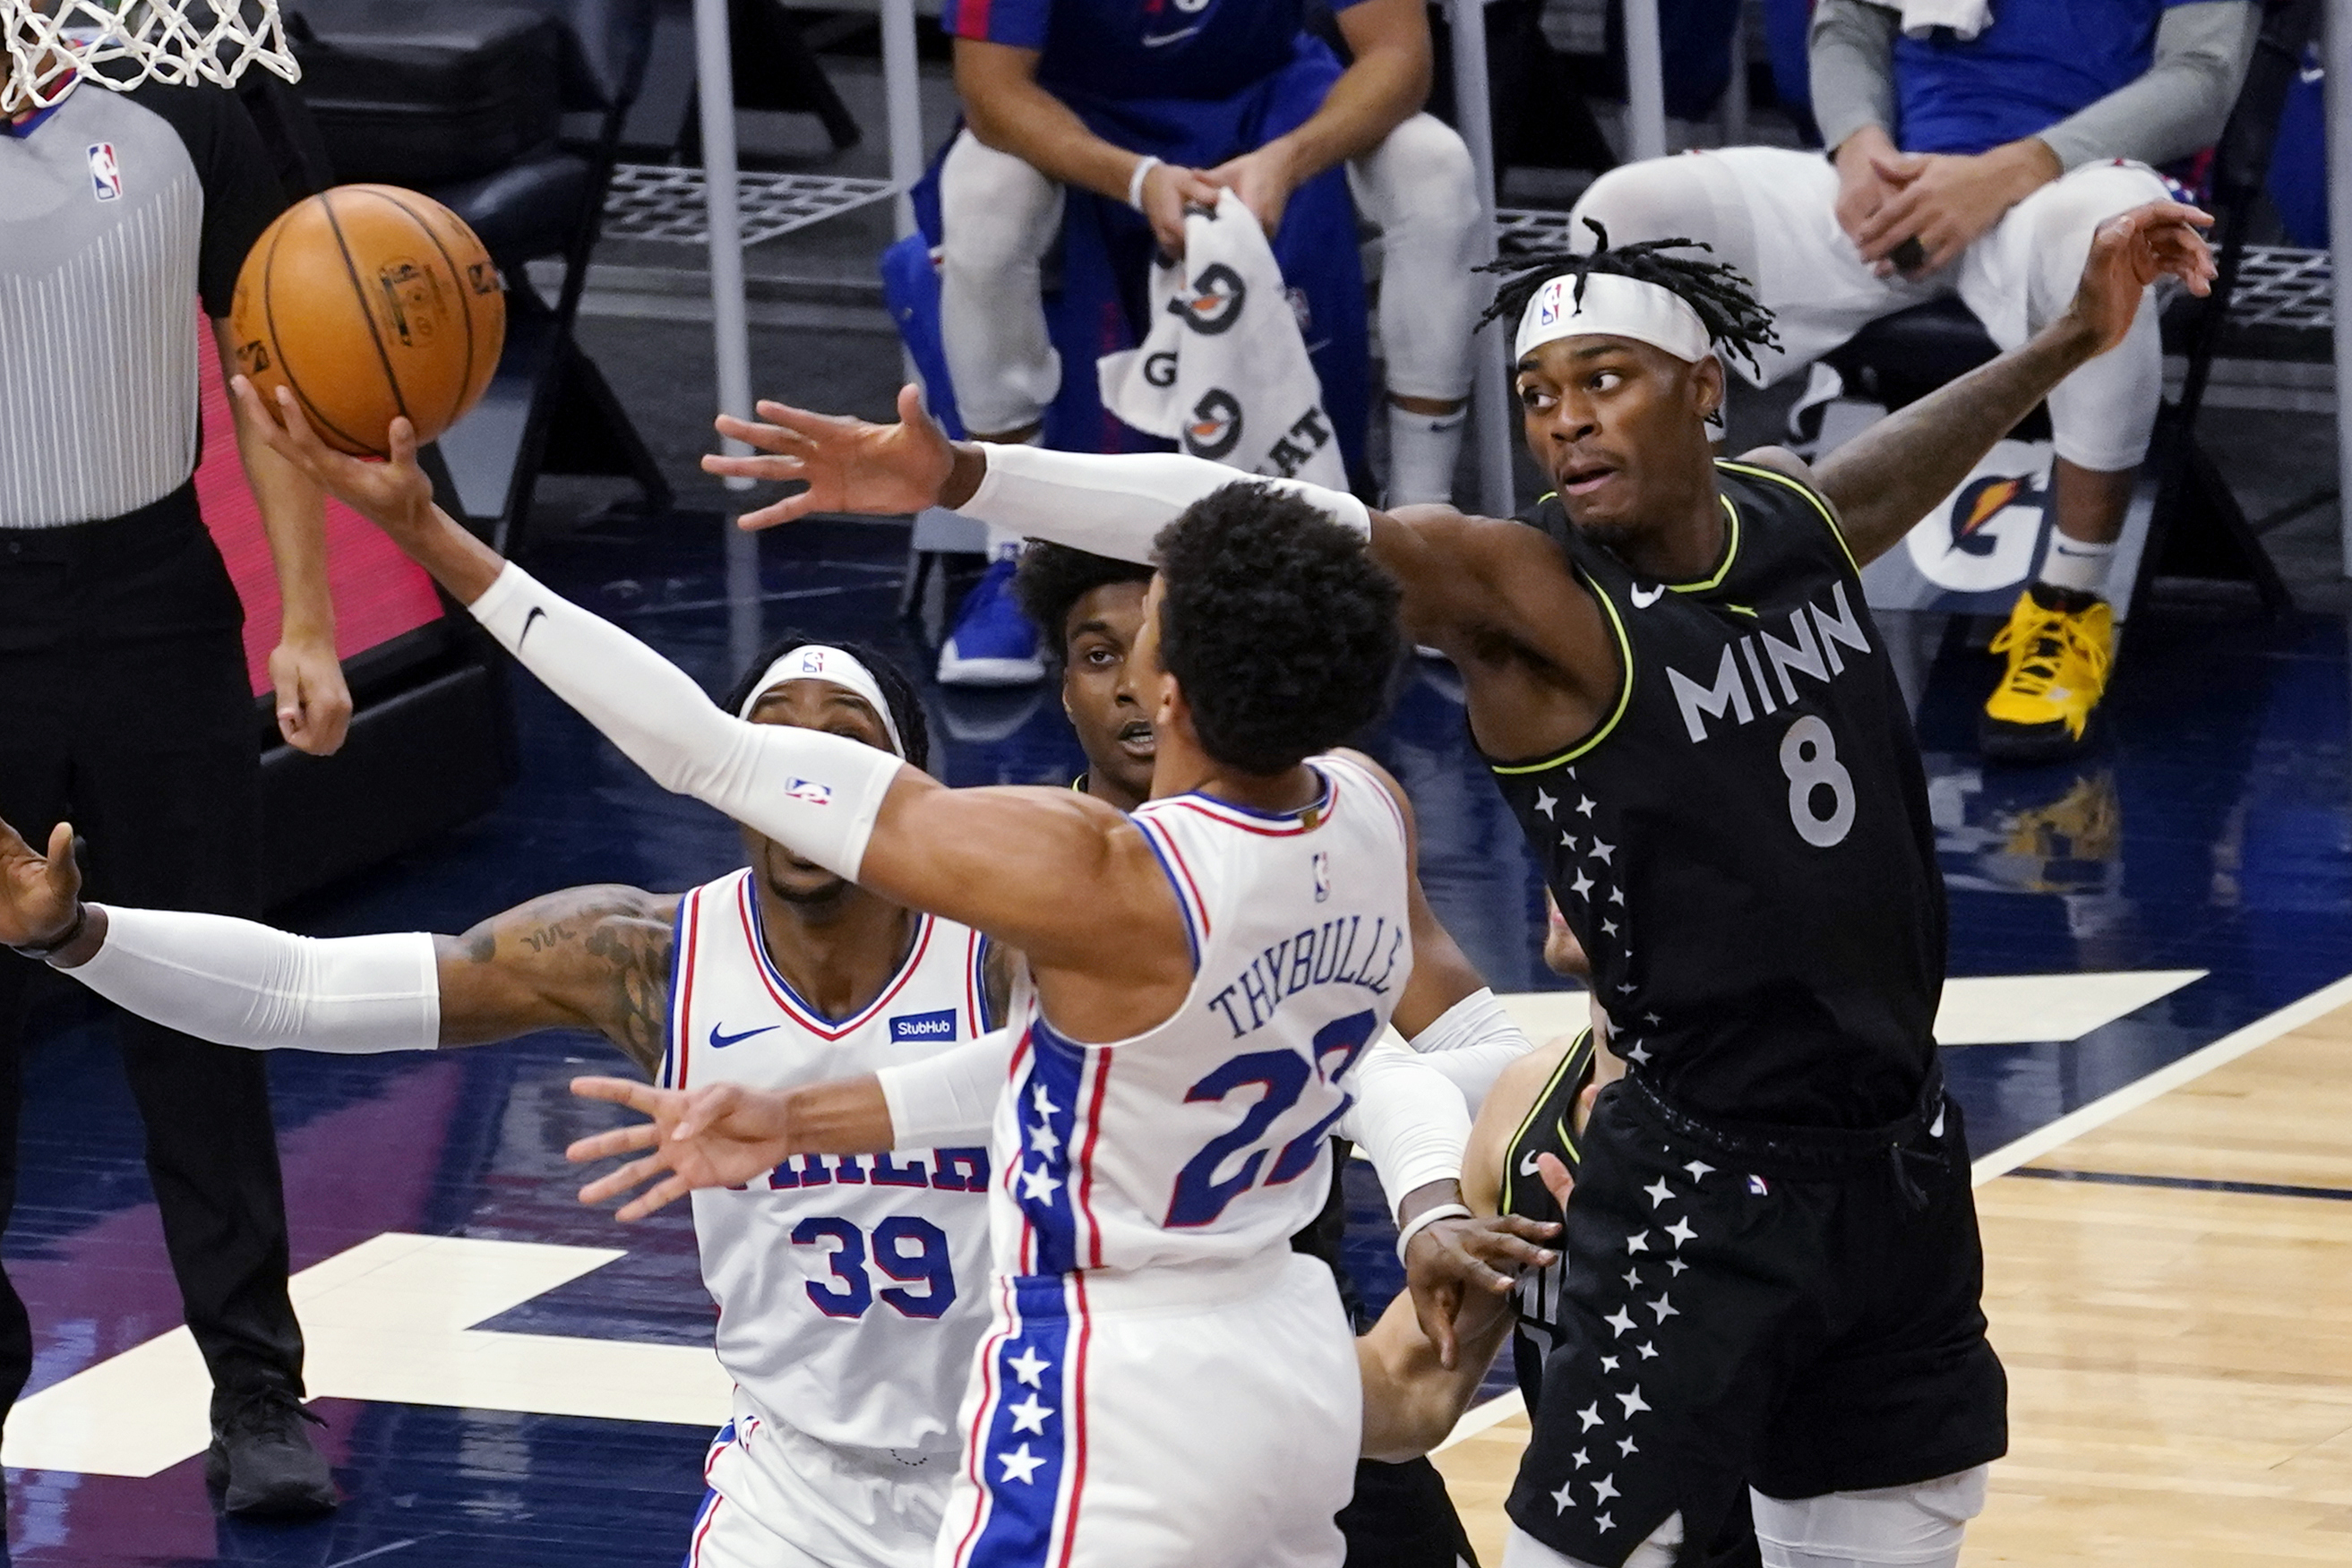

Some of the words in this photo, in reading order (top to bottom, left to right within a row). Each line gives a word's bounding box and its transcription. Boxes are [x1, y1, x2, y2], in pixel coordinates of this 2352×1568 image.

[1255, 407, 1329, 477] AT
[1666, 579, 1872, 743] MINN
[1780, 715, 1856, 847] 8
[897, 1020, 950, 1035] StubHub
[1163, 1008, 1378, 1228] 22
[790, 1216, 957, 1319] 39
